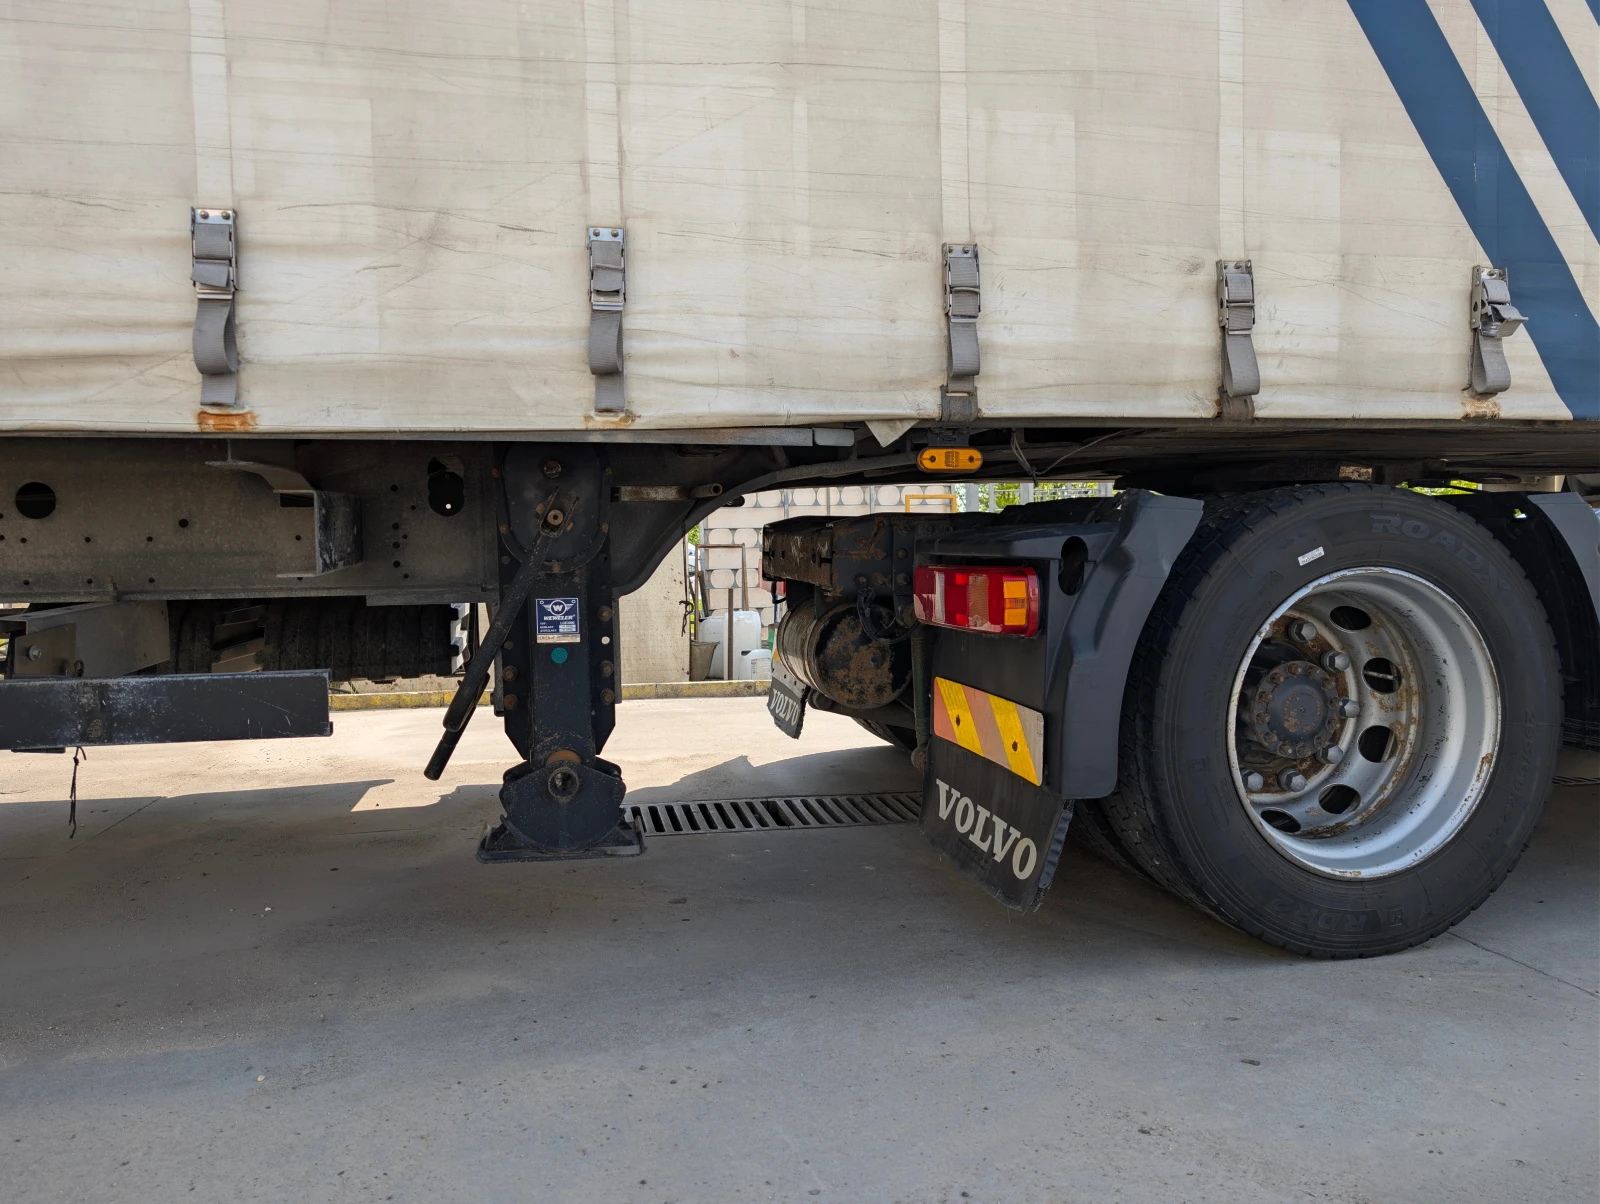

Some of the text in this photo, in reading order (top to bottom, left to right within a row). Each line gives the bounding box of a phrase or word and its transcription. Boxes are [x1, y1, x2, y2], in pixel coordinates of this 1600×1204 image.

[1370, 514, 1512, 594] ROADX
[552, 604, 563, 612] W
[770, 689, 799, 726] VOLVO
[936, 779, 1037, 879] VOLVO
